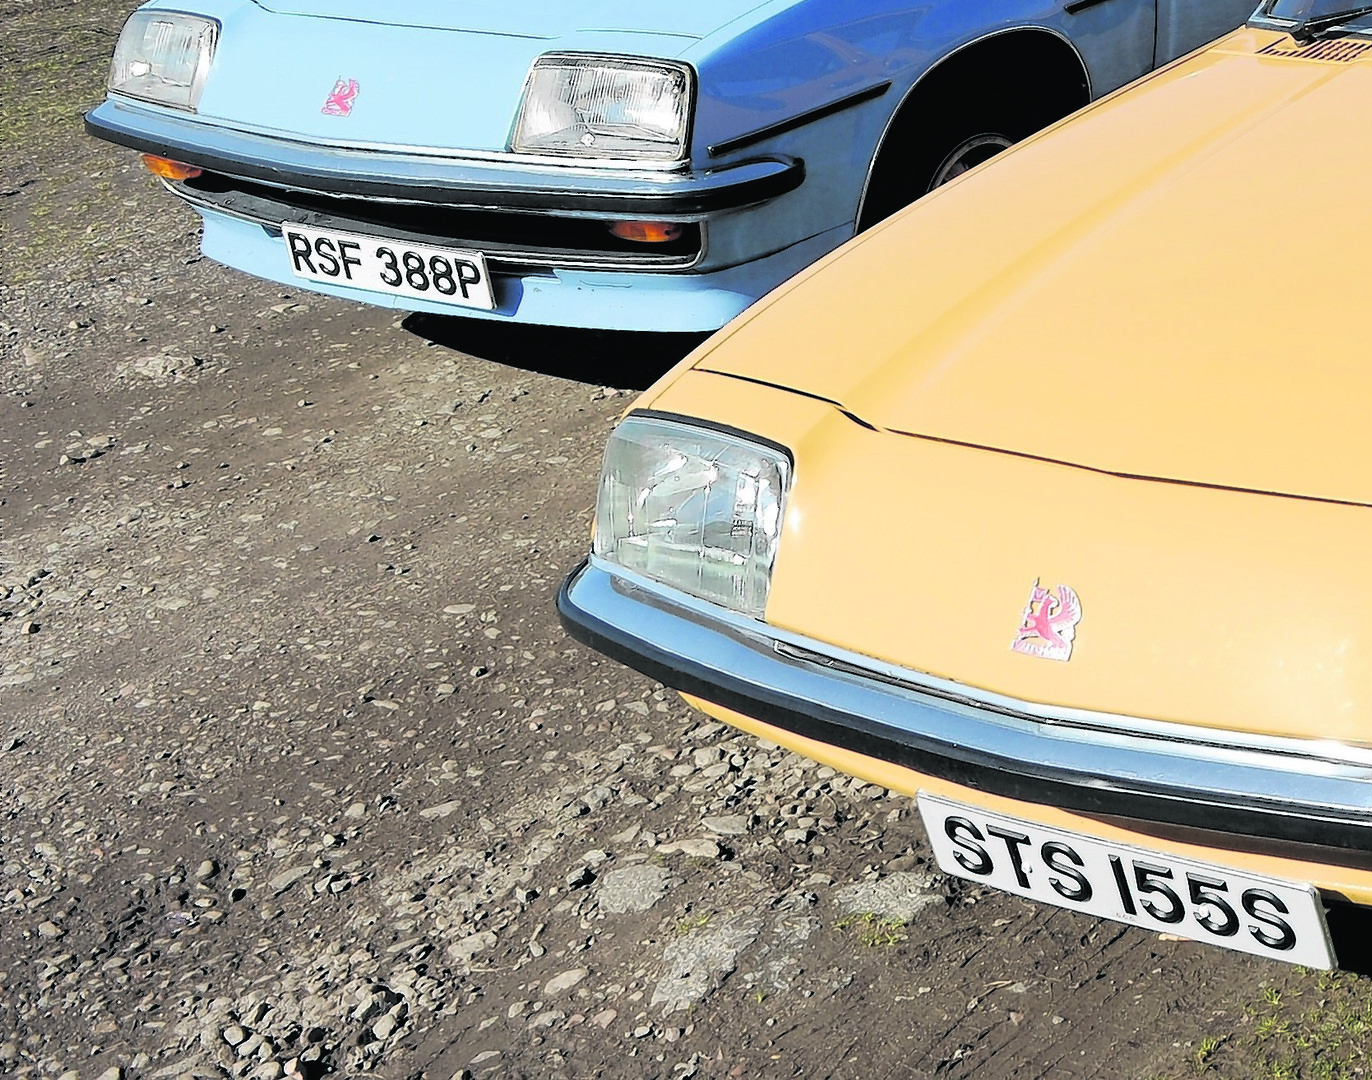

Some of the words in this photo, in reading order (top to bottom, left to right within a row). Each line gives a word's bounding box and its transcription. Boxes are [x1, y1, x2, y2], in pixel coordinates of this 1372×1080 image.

[287, 232, 362, 280] RSF
[376, 246, 481, 299] 388P
[944, 815, 1093, 902] STS
[1108, 853, 1297, 951] 155S
